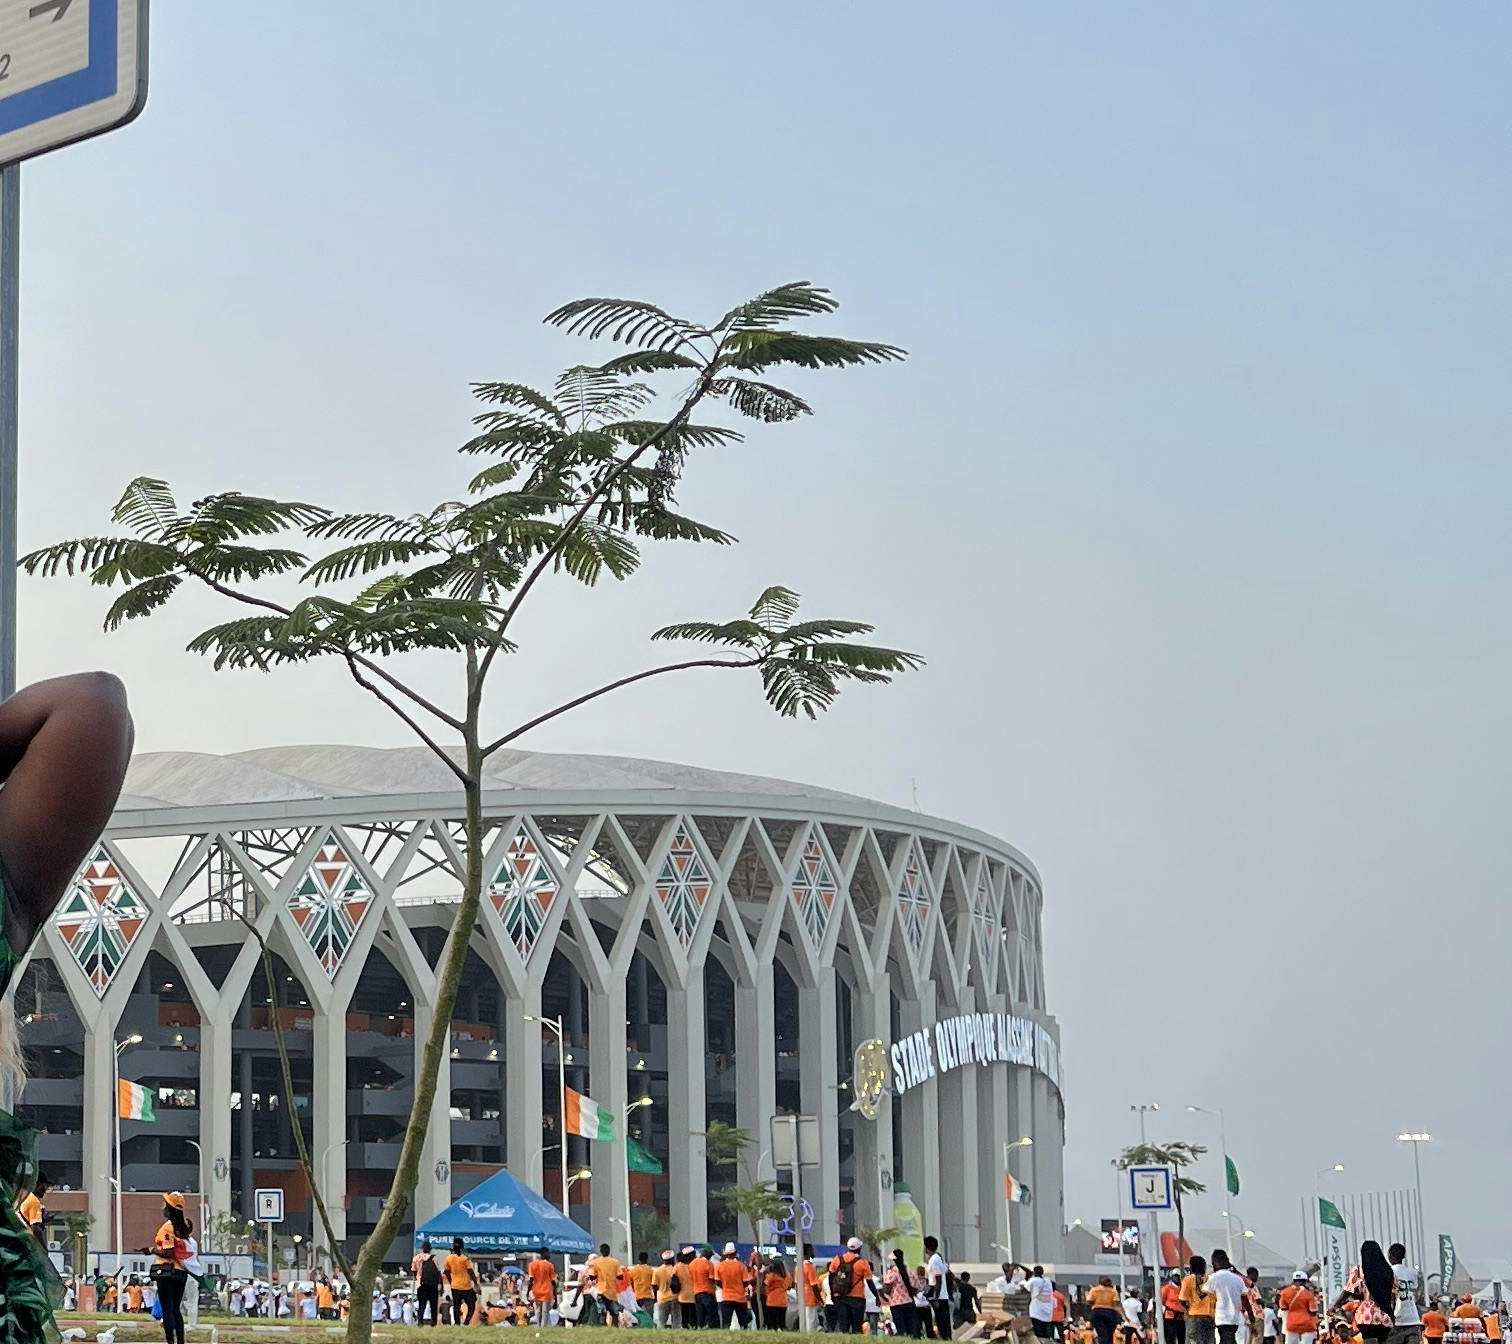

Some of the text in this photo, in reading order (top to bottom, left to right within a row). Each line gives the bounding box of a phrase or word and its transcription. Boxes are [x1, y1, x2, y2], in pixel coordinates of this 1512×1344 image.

[891, 1027, 936, 1095] STADE
[935, 1012, 997, 1072] OLYMPIQUE
[1146, 1179, 1154, 1193] J
[265, 1198, 273, 1209] R
[463, 1235, 495, 1245] OURCE
[1331, 1235, 1343, 1291] APSONIC
